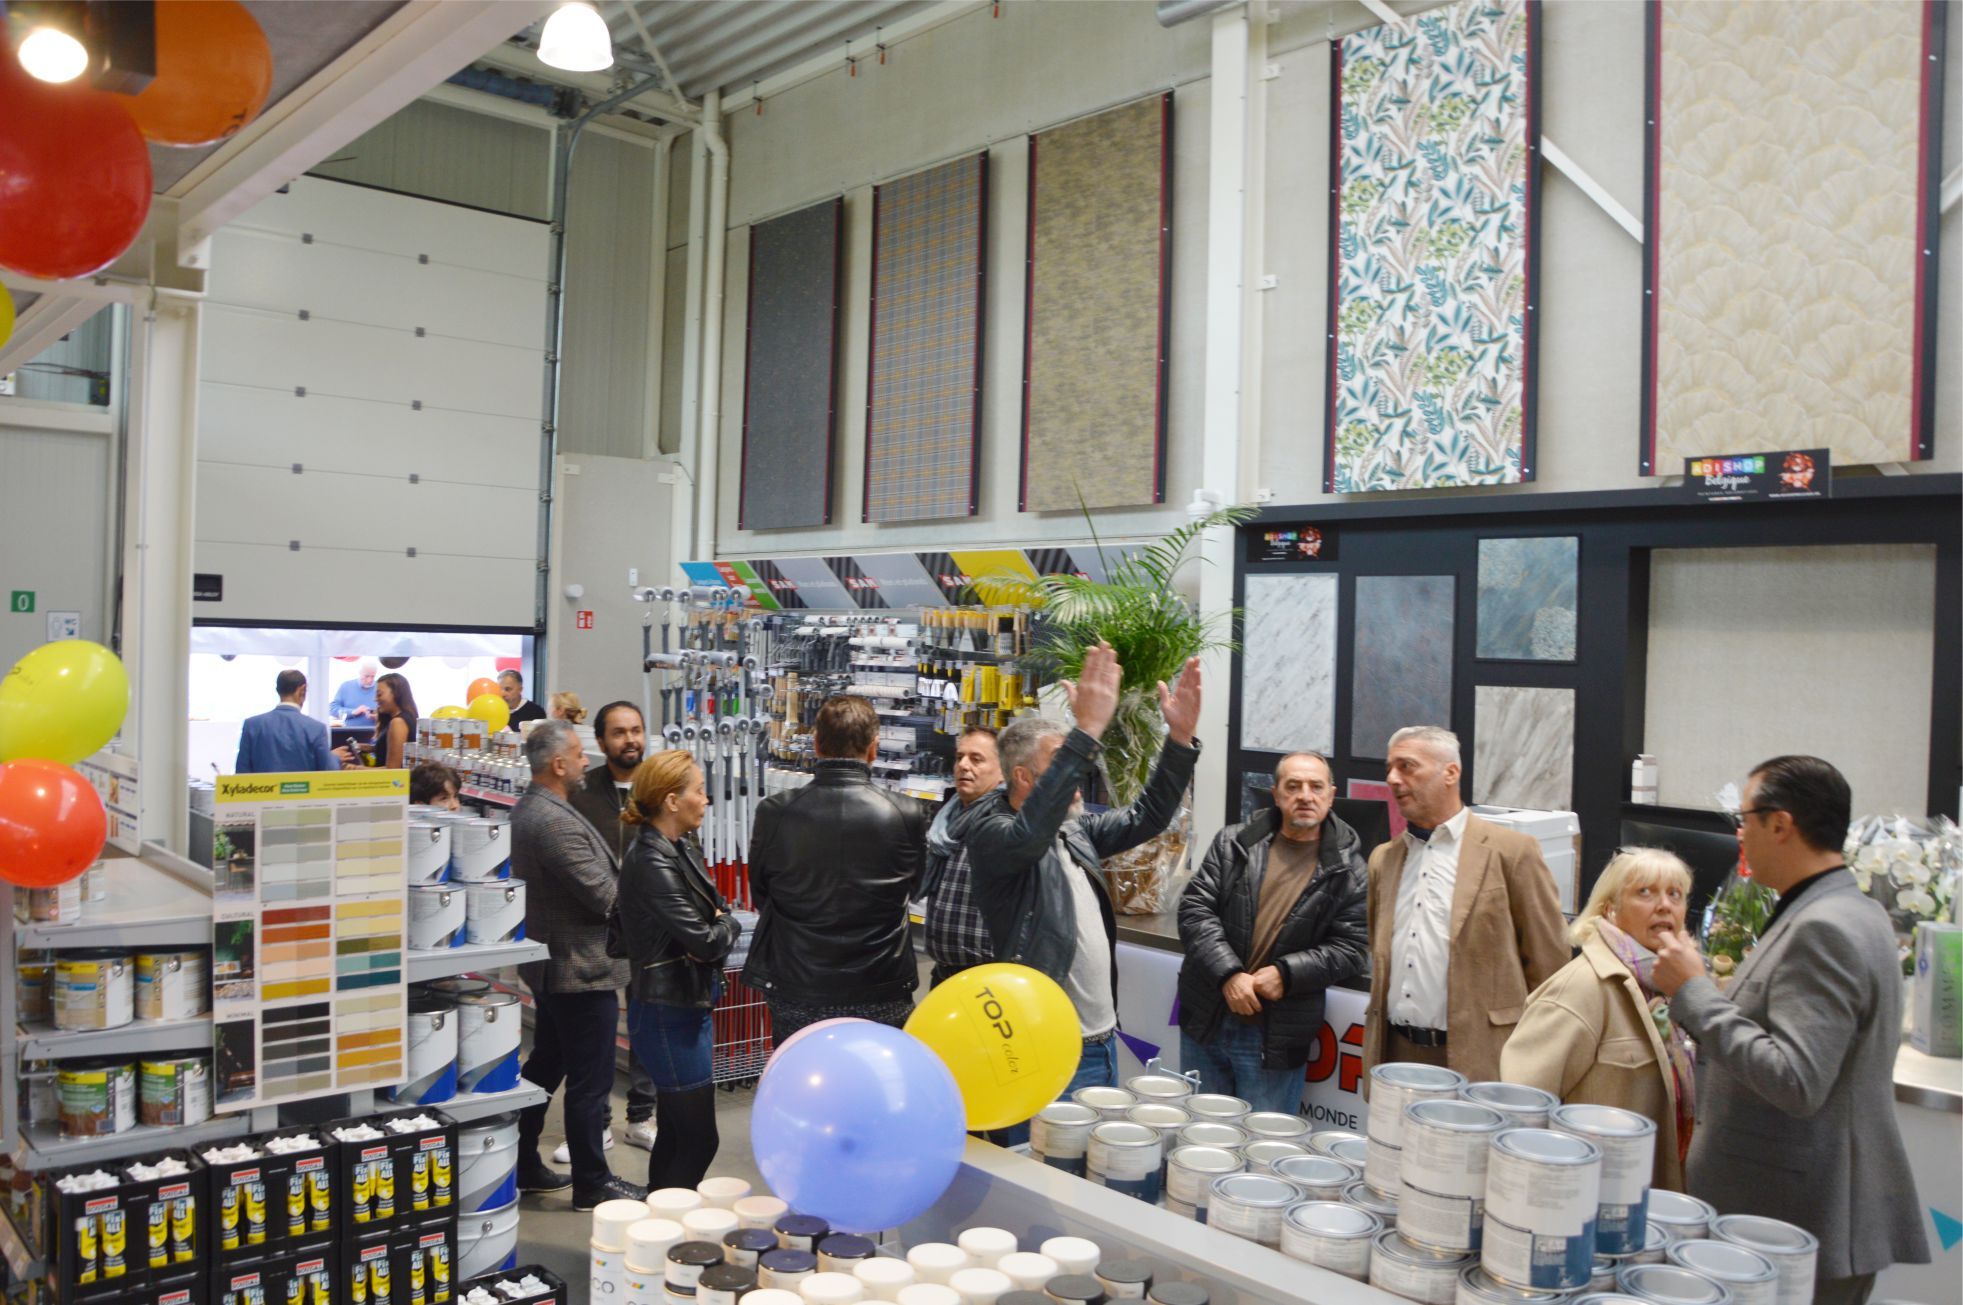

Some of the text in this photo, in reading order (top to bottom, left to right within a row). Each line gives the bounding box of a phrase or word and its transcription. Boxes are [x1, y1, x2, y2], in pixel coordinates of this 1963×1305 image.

[222, 782, 278, 797] Xyladecor
[975, 986, 1020, 1073] TOP color
[1299, 1101, 1358, 1130] MONDE
